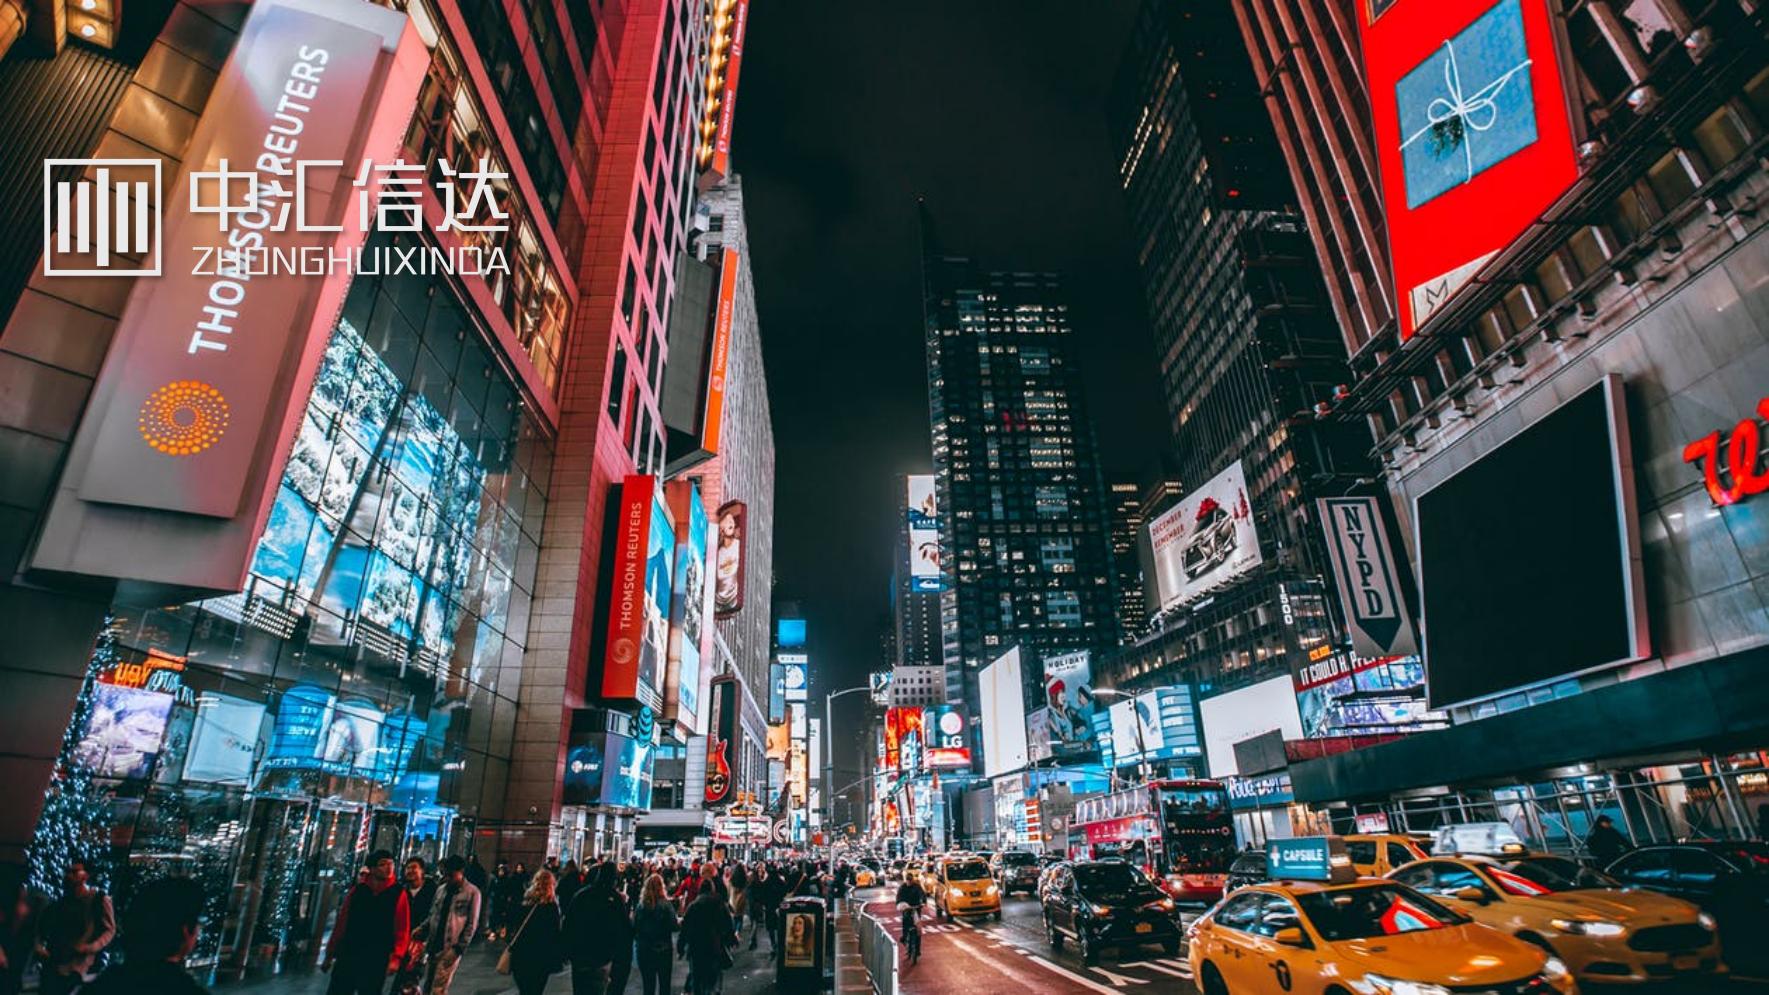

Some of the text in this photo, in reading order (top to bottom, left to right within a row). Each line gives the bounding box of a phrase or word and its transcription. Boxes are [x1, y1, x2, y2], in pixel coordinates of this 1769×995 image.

[187, 44, 330, 355] THOMSON REUTERS
[619, 501, 643, 631] THOMSON REUTERS
[1342, 506, 1384, 616] NYPD
[1278, 584, 1294, 626] 1500
[1048, 655, 1085, 668] HOLIDAY
[1300, 667, 1310, 686] IT
[1309, 657, 1338, 682] COULD
[942, 735, 963, 749] LG
[1283, 848, 1324, 862] CAPSULE
